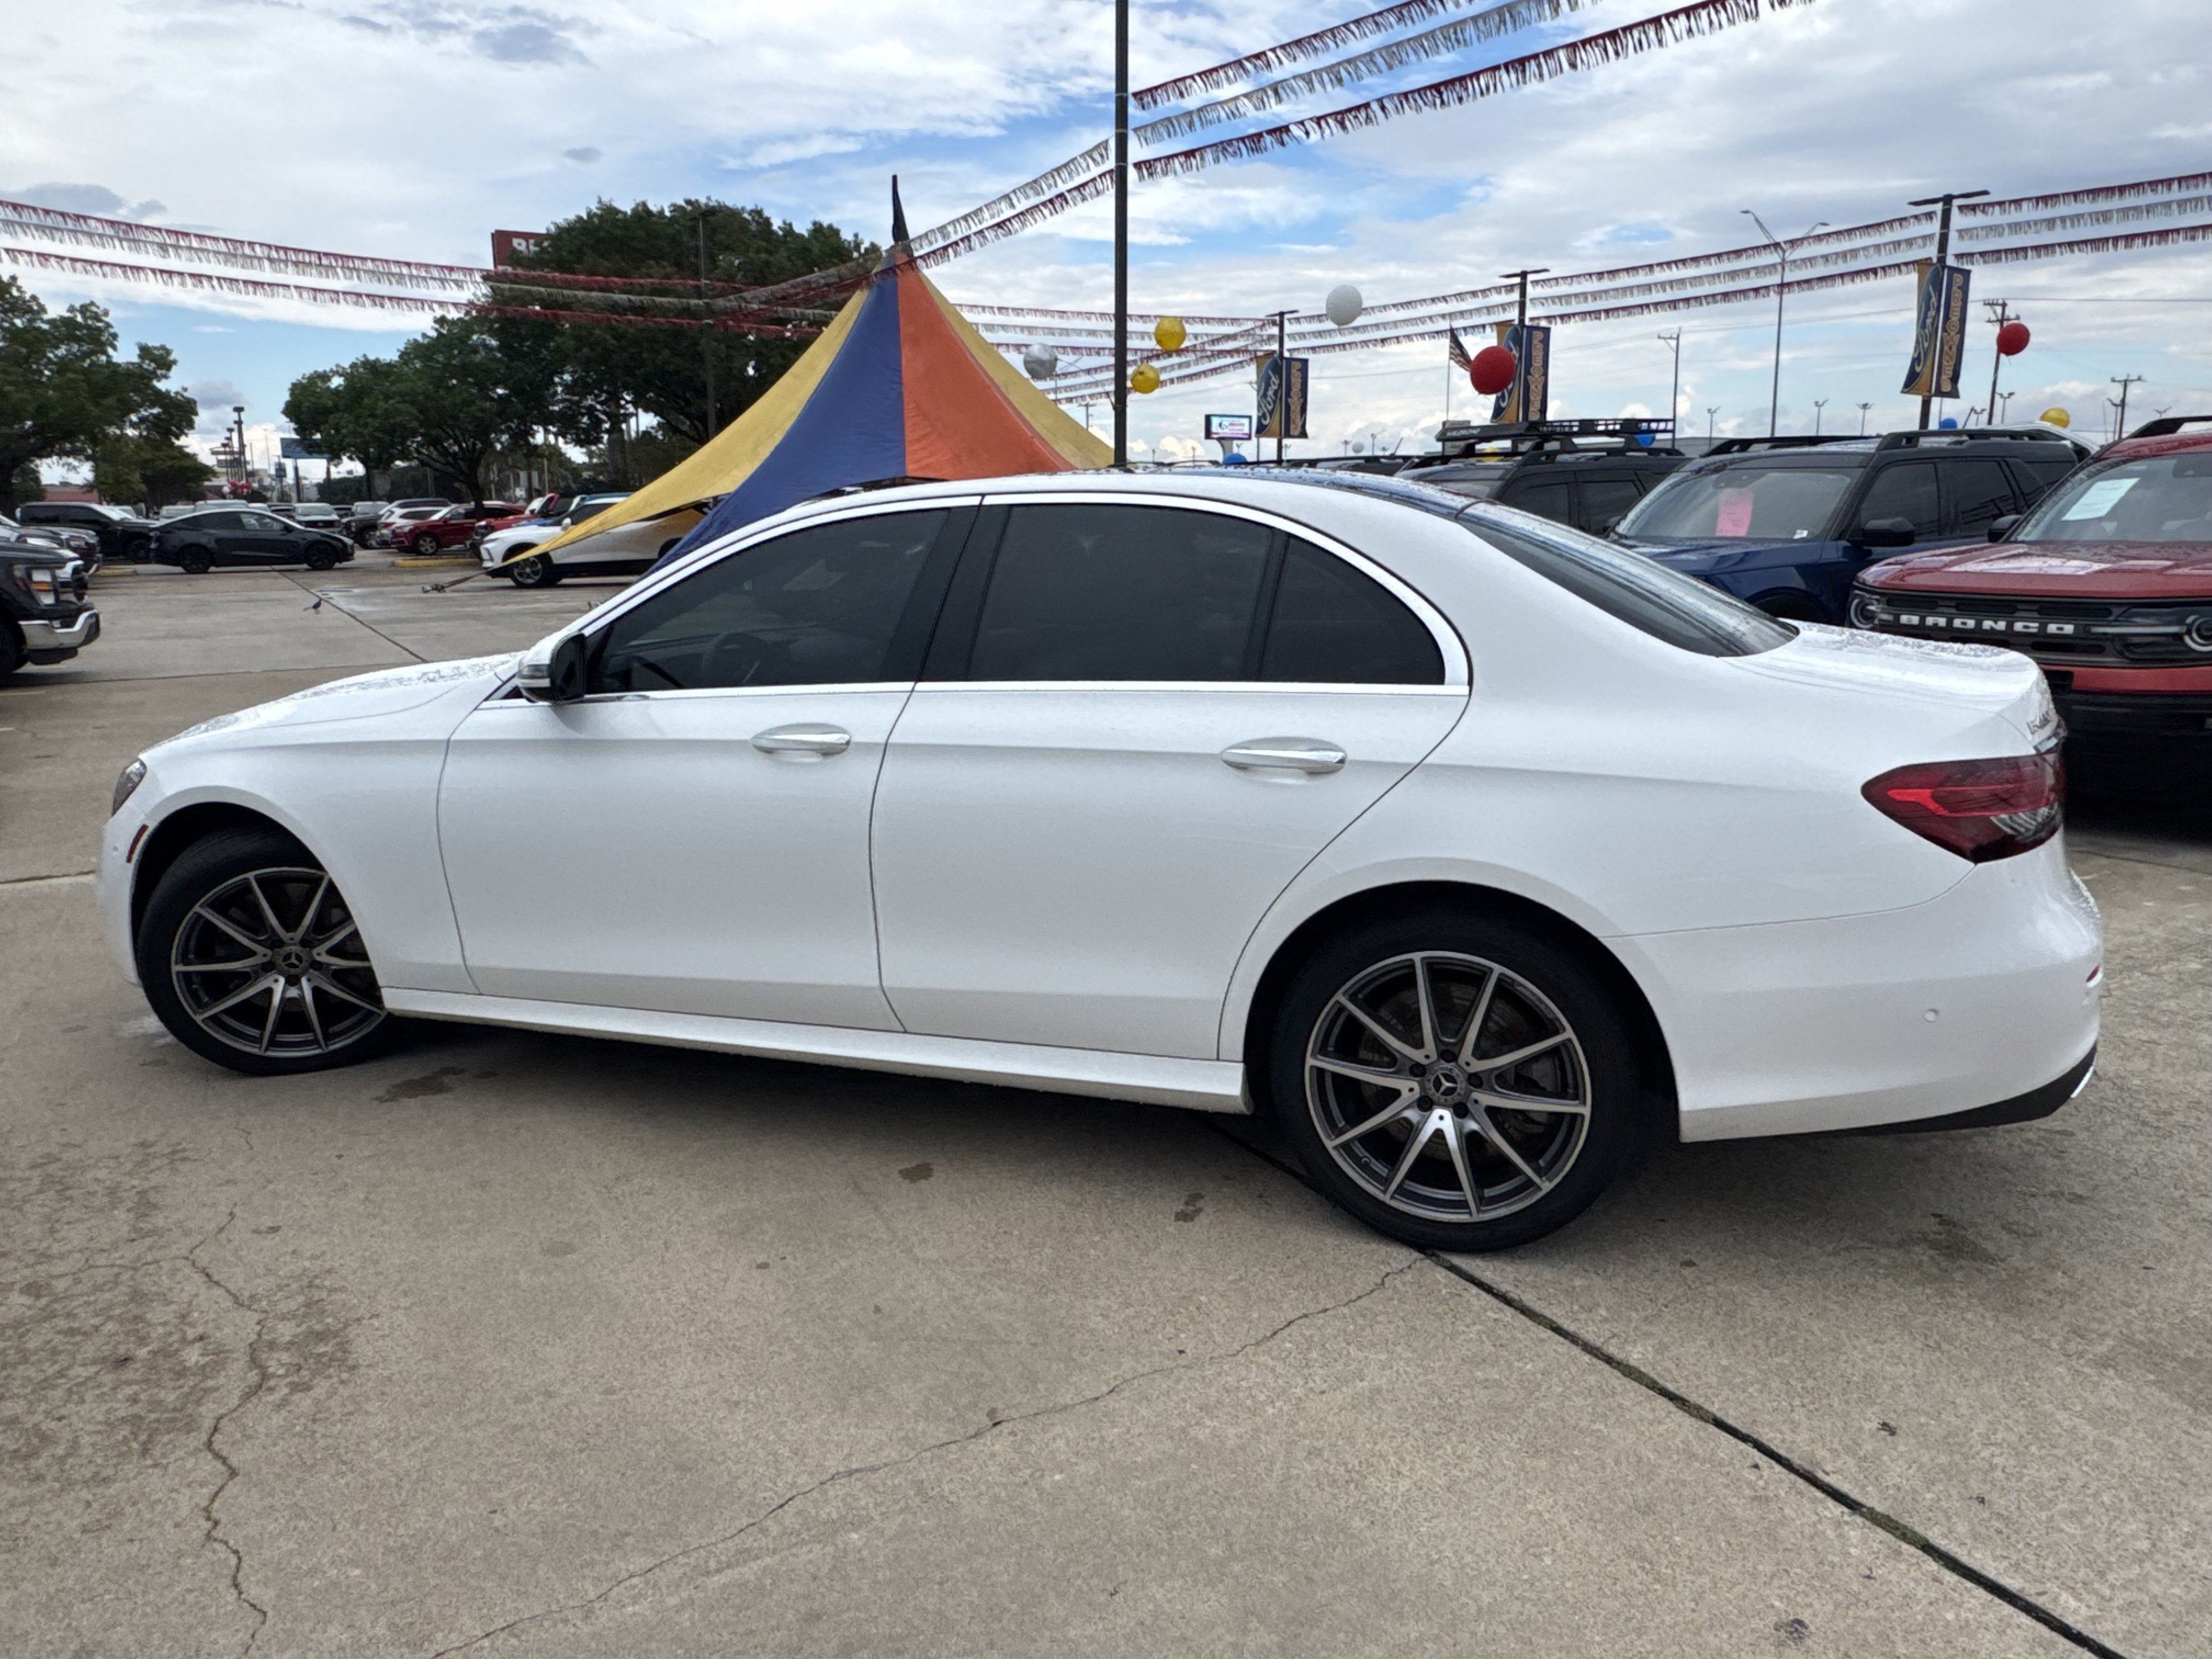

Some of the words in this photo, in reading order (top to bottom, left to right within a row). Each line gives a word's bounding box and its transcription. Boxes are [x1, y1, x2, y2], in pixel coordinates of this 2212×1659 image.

[1913, 284, 1939, 373] Ford
[1257, 370, 1279, 426] Ford
[1899, 614, 2075, 635] BRONCO
